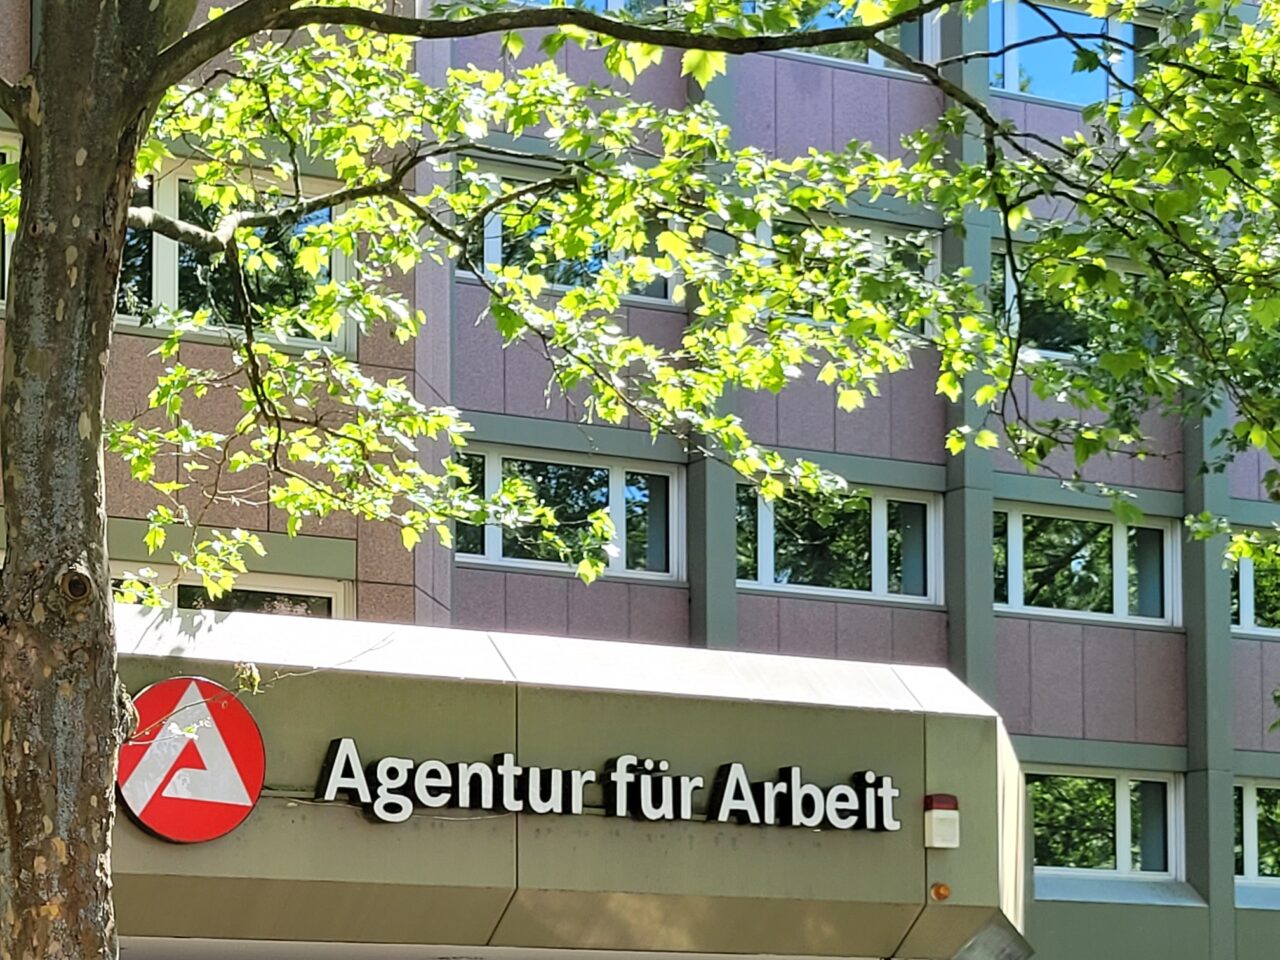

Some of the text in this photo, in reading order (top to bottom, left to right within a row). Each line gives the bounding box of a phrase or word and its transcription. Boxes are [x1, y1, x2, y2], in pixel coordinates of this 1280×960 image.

[323, 737, 901, 831] Agentur für Arbeit
